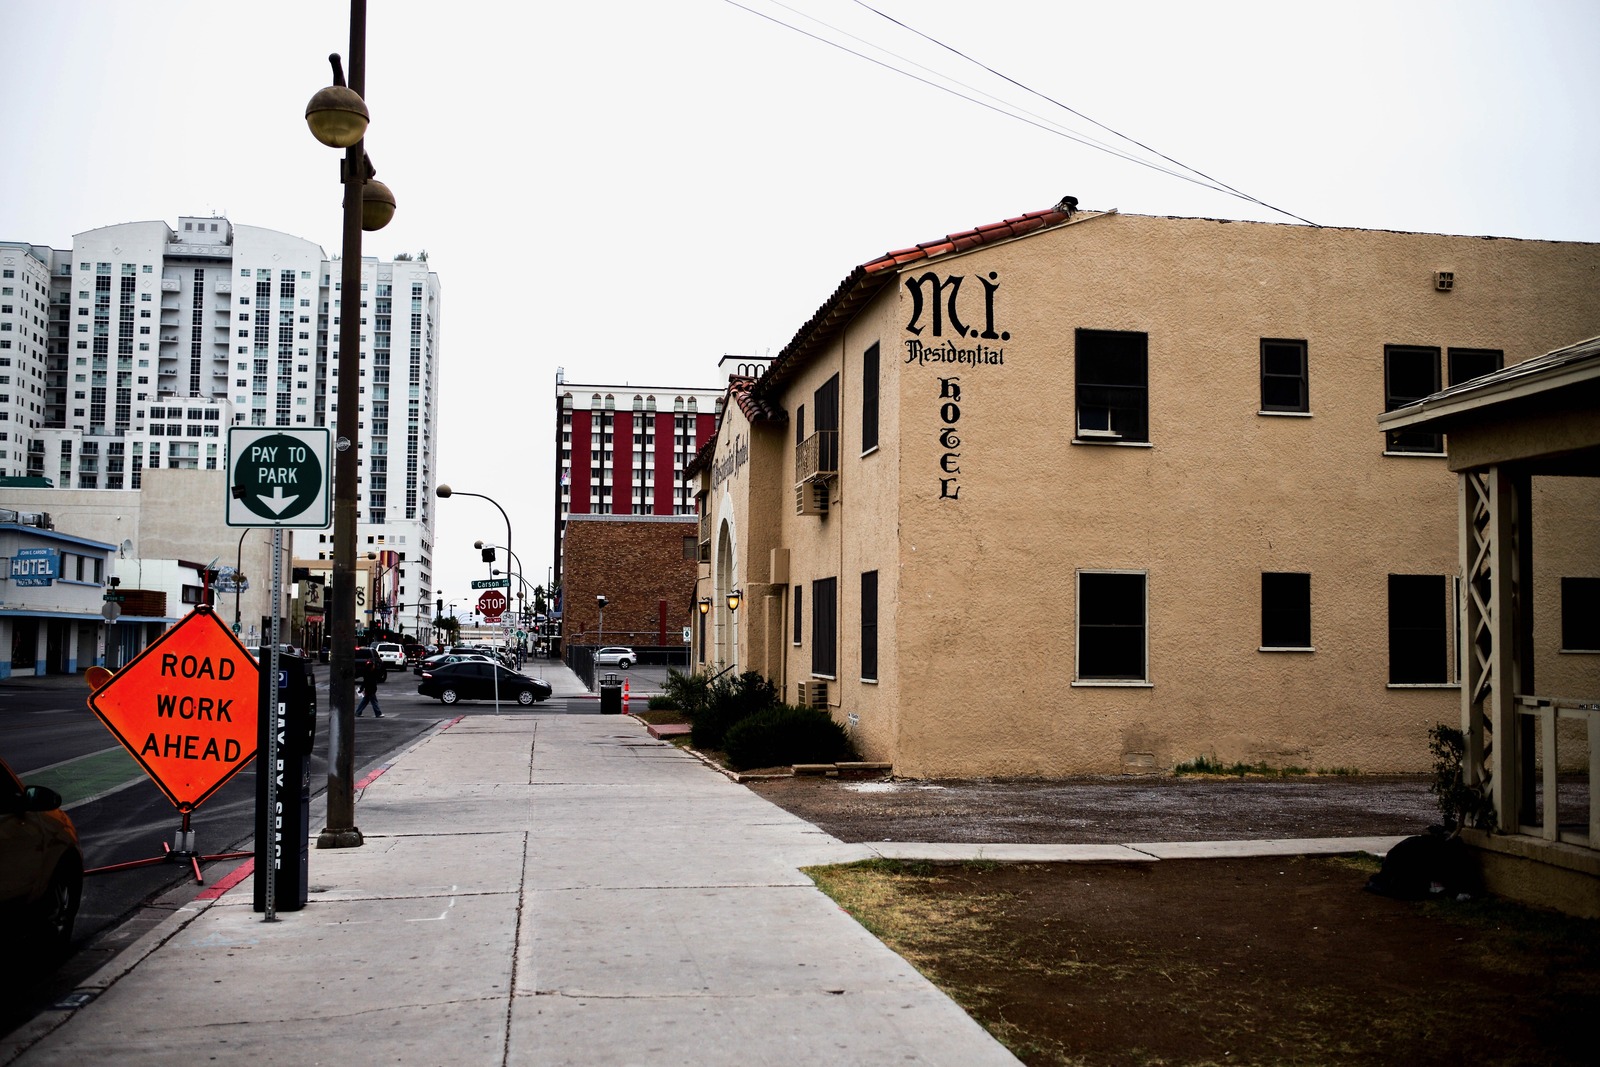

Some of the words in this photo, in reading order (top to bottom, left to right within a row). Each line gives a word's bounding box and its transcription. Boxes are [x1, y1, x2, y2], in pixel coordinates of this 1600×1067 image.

[904, 339, 1004, 368] Residential
[251, 446, 278, 463] PAY
[288, 446, 306, 463] TO
[258, 467, 298, 484] PARK
[12, 559, 53, 575] HOTEL
[480, 599, 505, 609] STOP
[161, 653, 235, 681] ROAD
[156, 694, 233, 722] WORK
[141, 732, 241, 763] AHEAD
